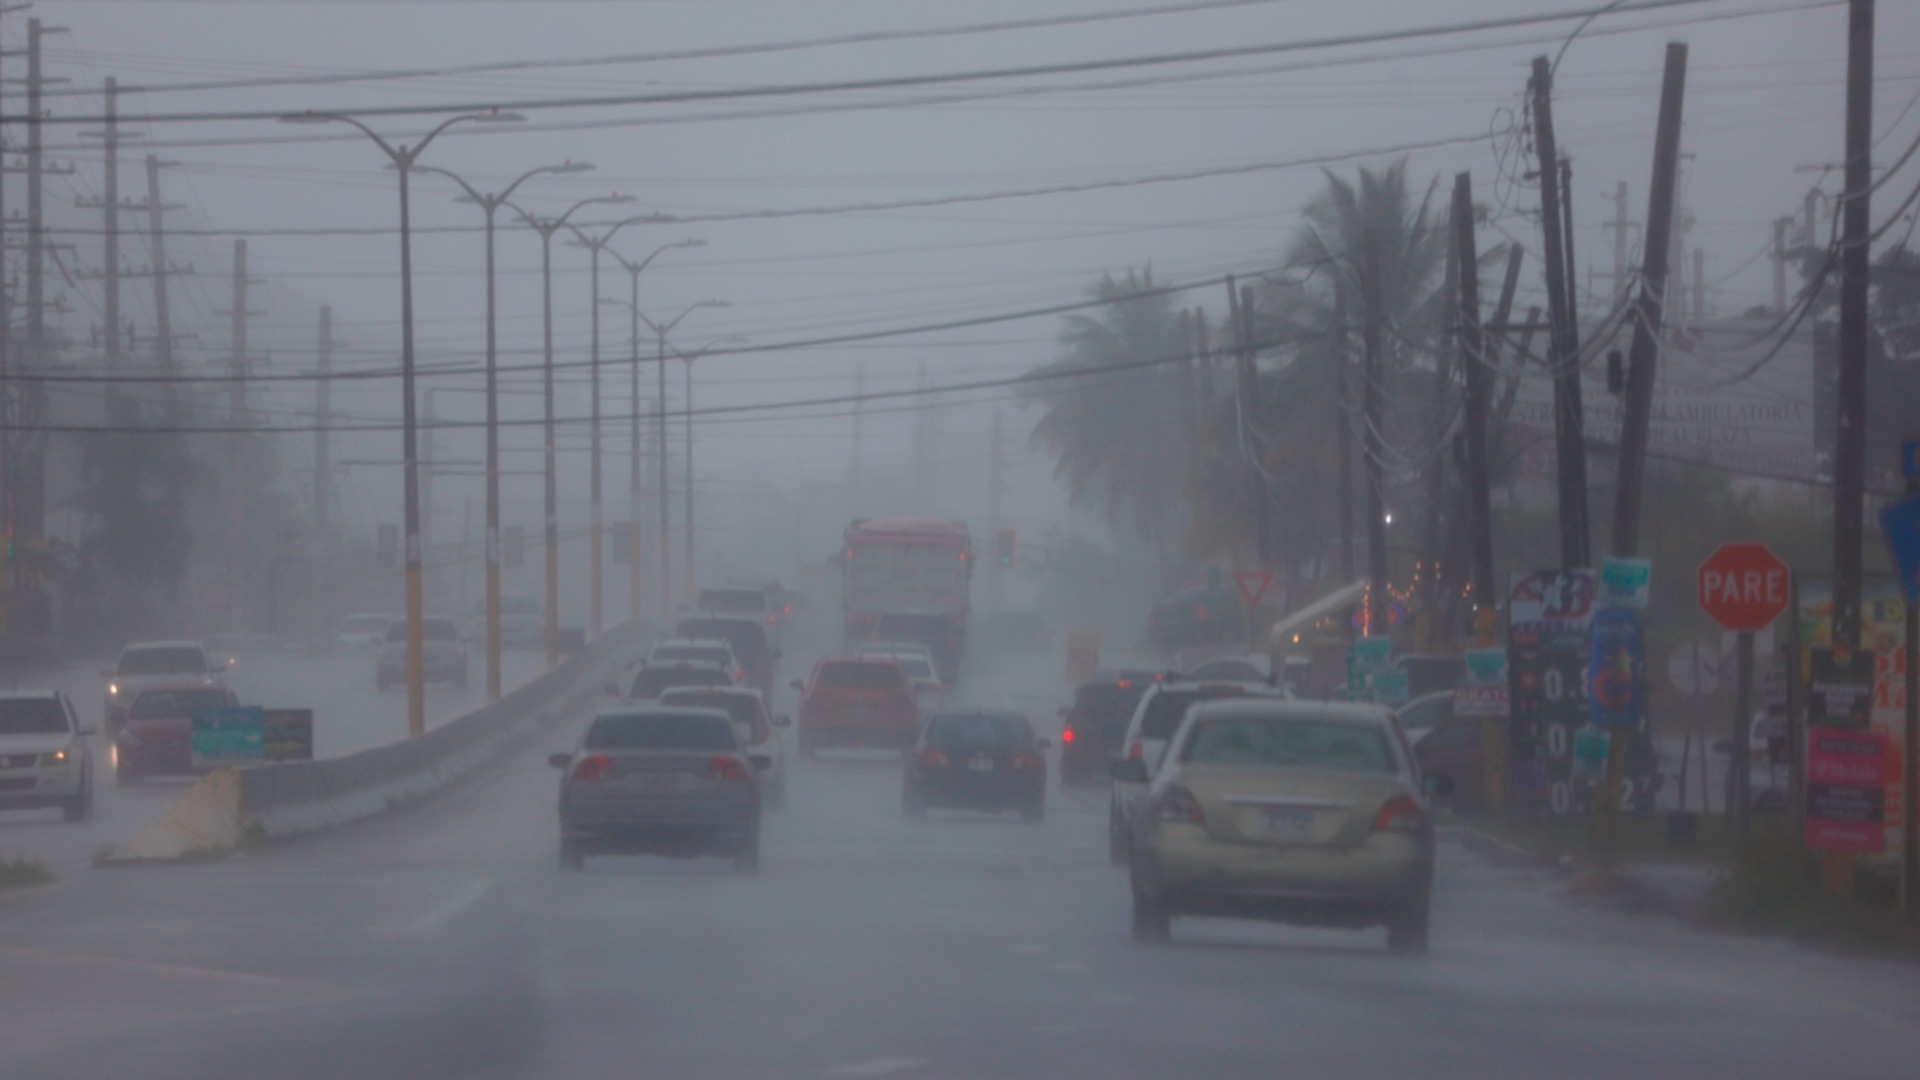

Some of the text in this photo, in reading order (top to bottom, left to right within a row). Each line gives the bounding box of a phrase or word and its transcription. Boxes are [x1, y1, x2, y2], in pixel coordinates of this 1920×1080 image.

[1673, 401, 1803, 422] AMBULATORIA
[1694, 426, 1751, 446] PLAZA
[1703, 569, 1783, 604] PARE
